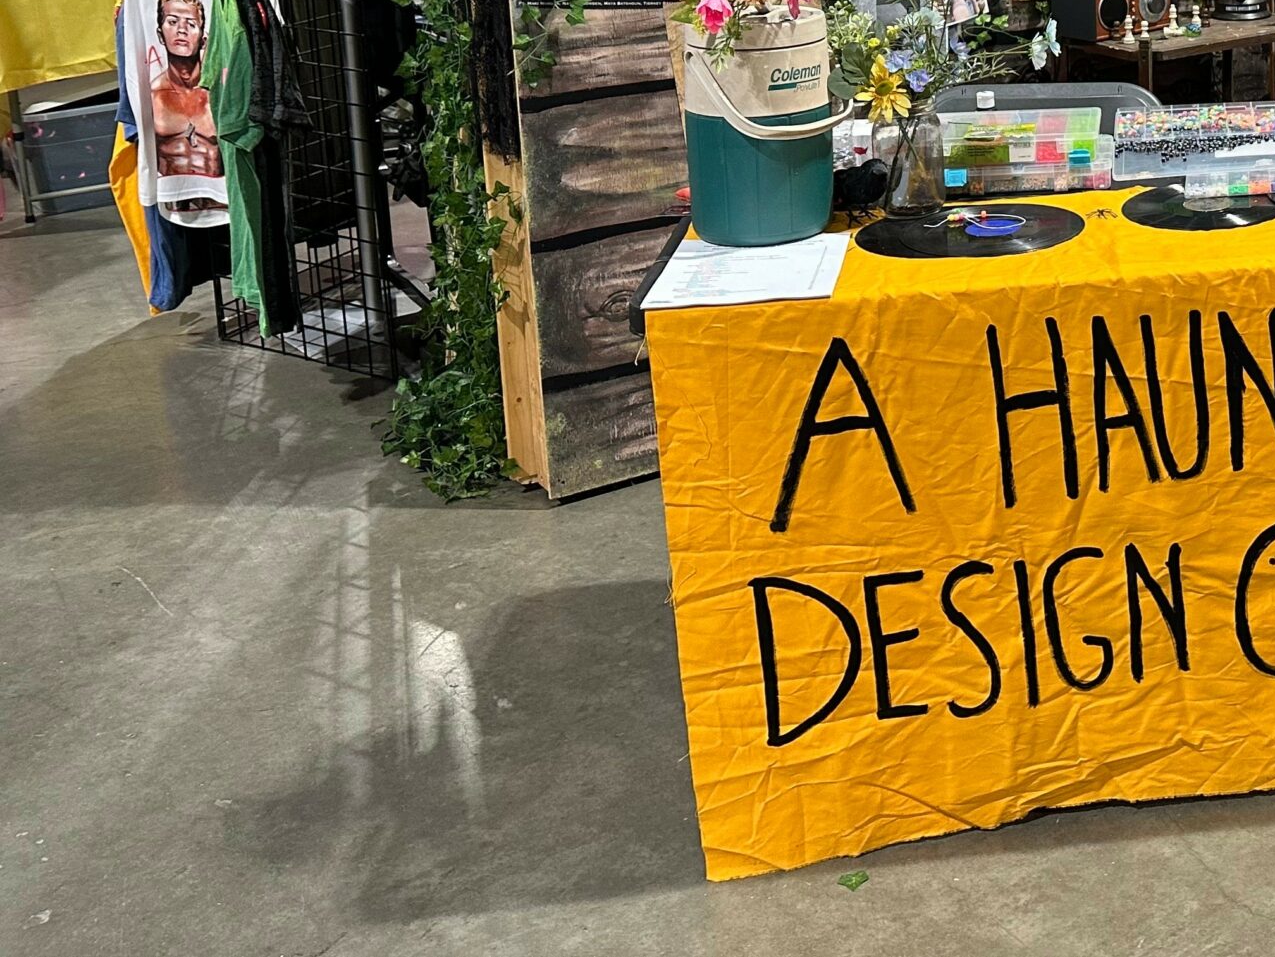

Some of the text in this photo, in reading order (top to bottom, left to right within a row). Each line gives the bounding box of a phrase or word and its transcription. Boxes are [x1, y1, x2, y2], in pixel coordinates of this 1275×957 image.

[771, 64, 821, 83] Coleman
[769, 336, 916, 532] A
[747, 542, 1190, 747] DESIGN
